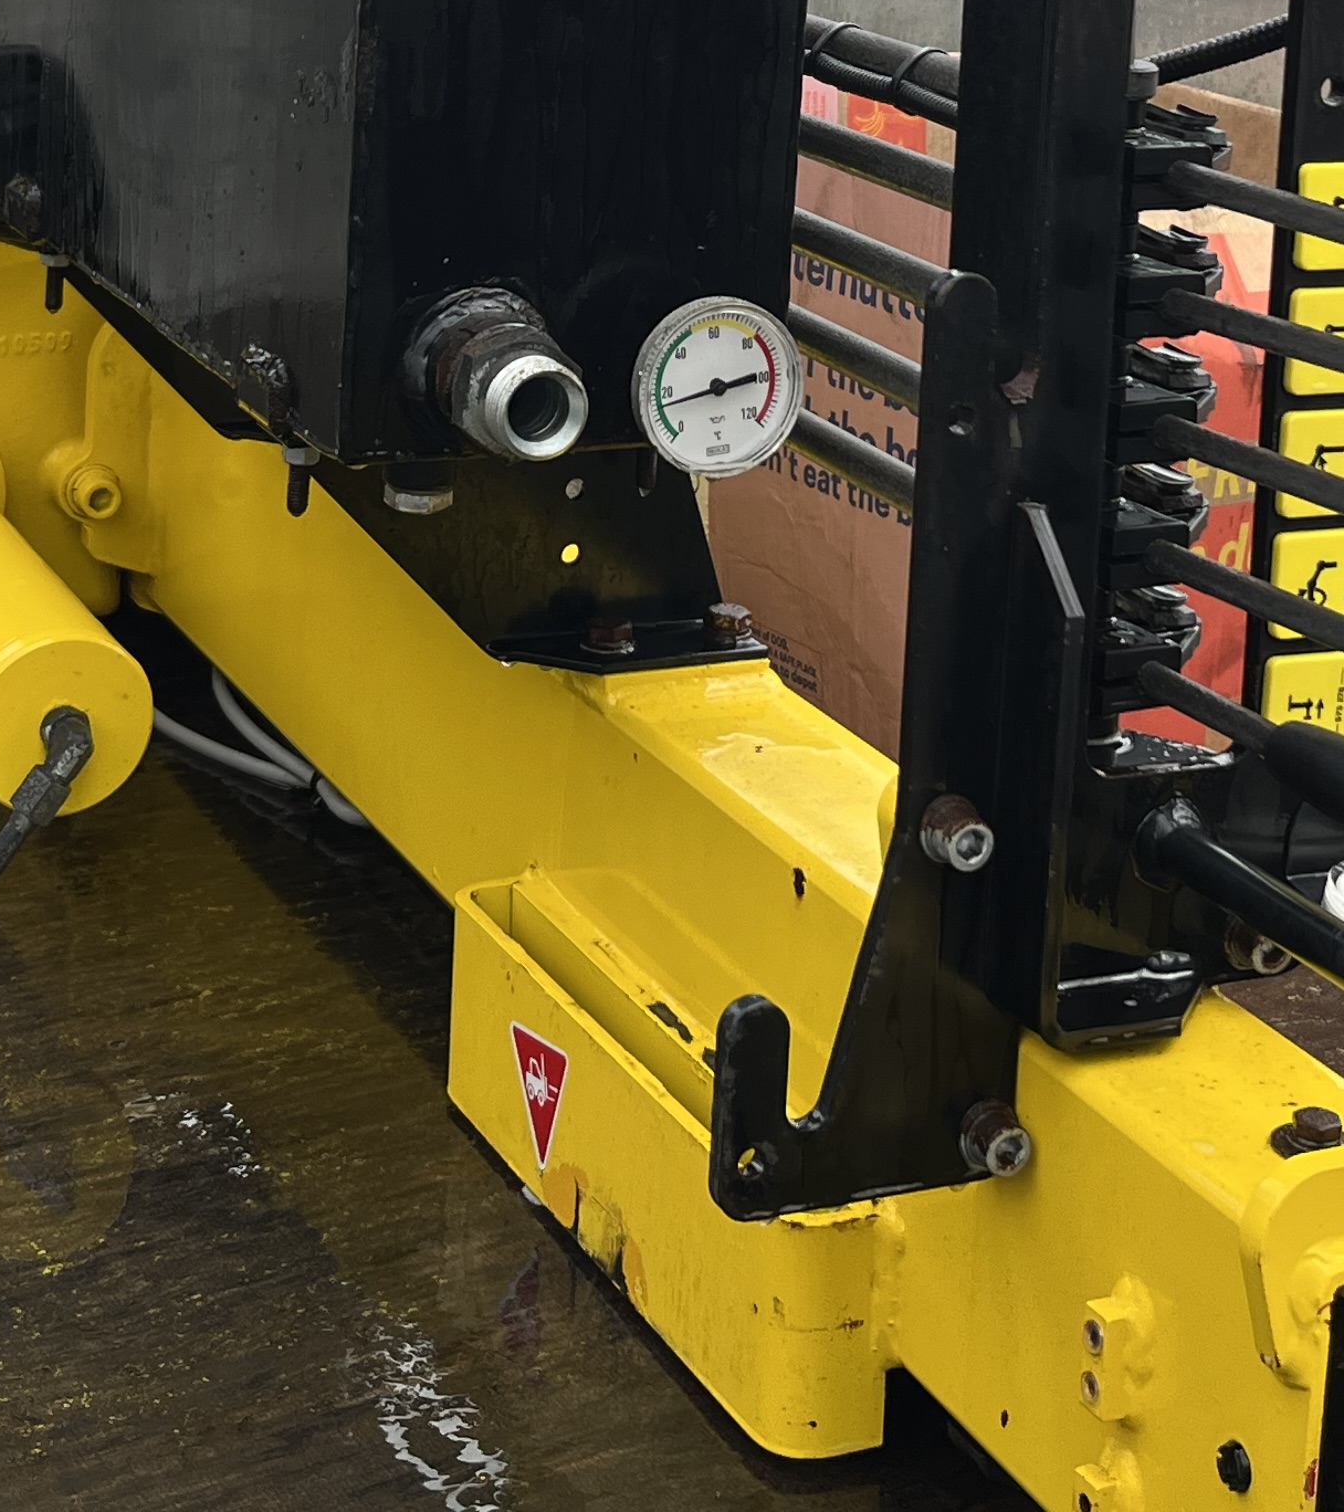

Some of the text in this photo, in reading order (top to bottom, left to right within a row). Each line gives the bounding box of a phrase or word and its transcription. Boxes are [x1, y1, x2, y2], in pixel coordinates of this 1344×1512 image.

[708, 326, 720, 339] 60
[675, 347, 686, 359] 40
[661, 386, 673, 399] 20
[741, 407, 757, 420] 120
[678, 420, 684, 433] 0
[804, 463, 841, 500] eat
